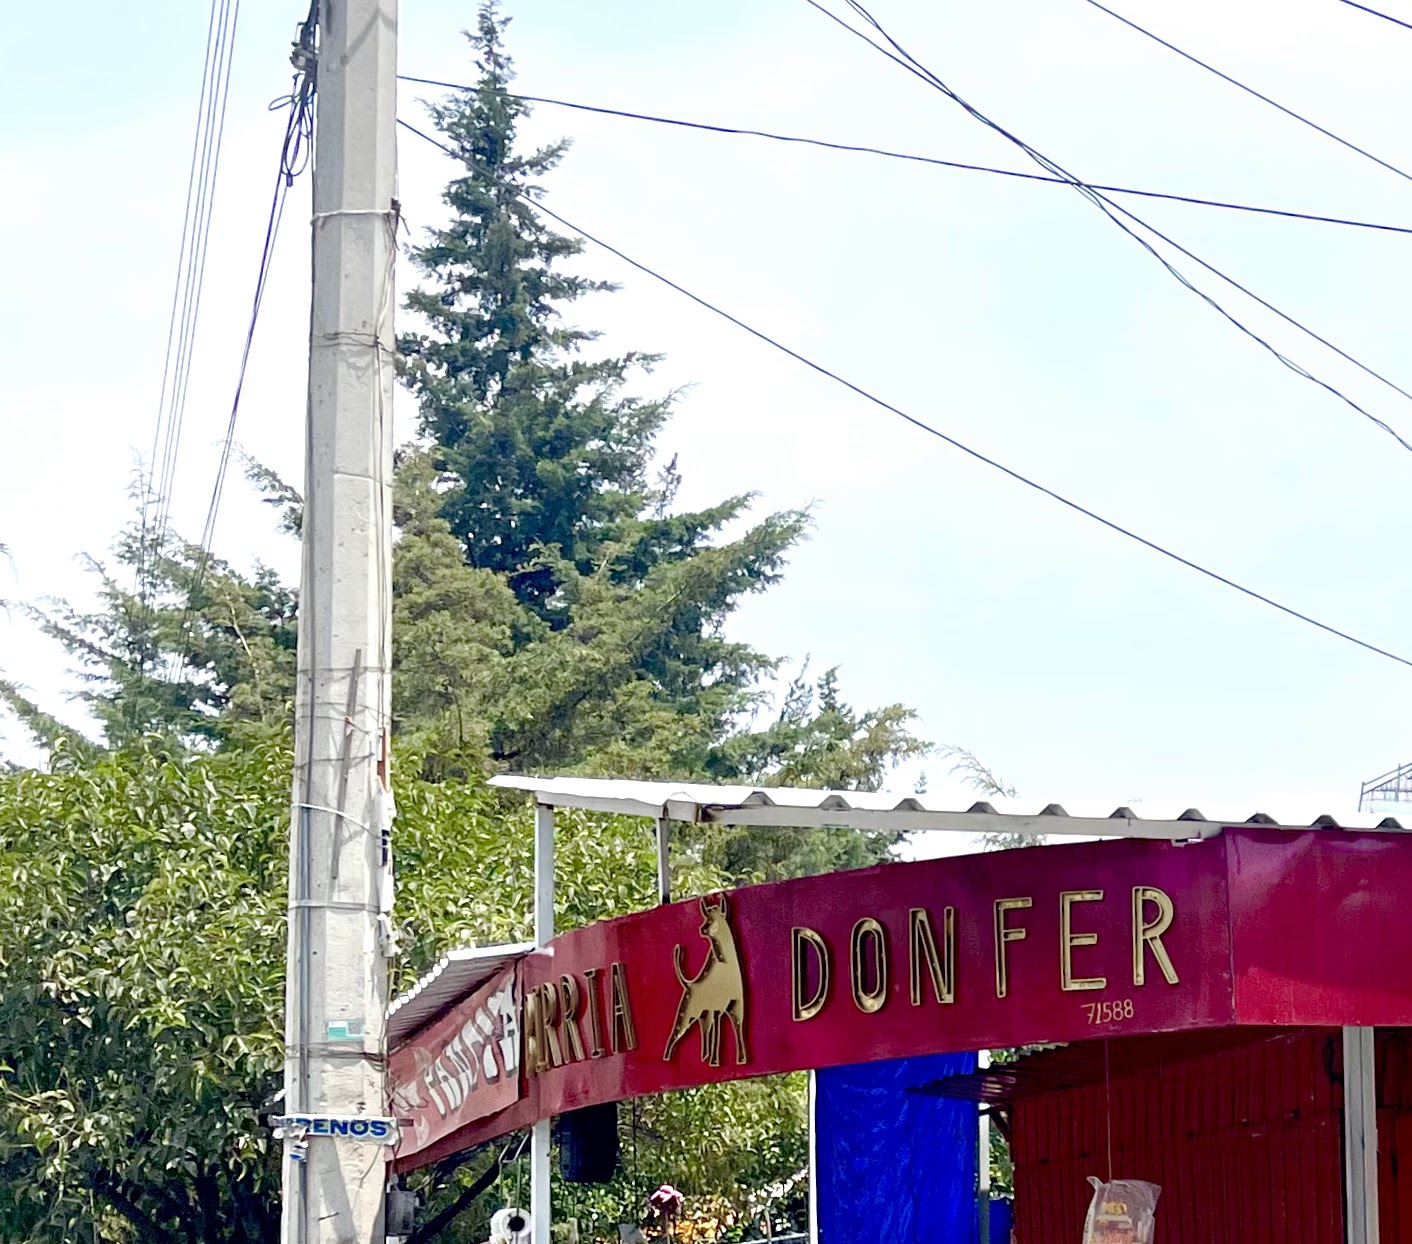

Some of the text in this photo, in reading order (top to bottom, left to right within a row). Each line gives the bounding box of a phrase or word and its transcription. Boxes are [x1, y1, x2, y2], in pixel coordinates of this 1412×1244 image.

[791, 906, 954, 1022] DON
[994, 886, 1179, 999] FER
[1080, 999, 1134, 1025] 71588
